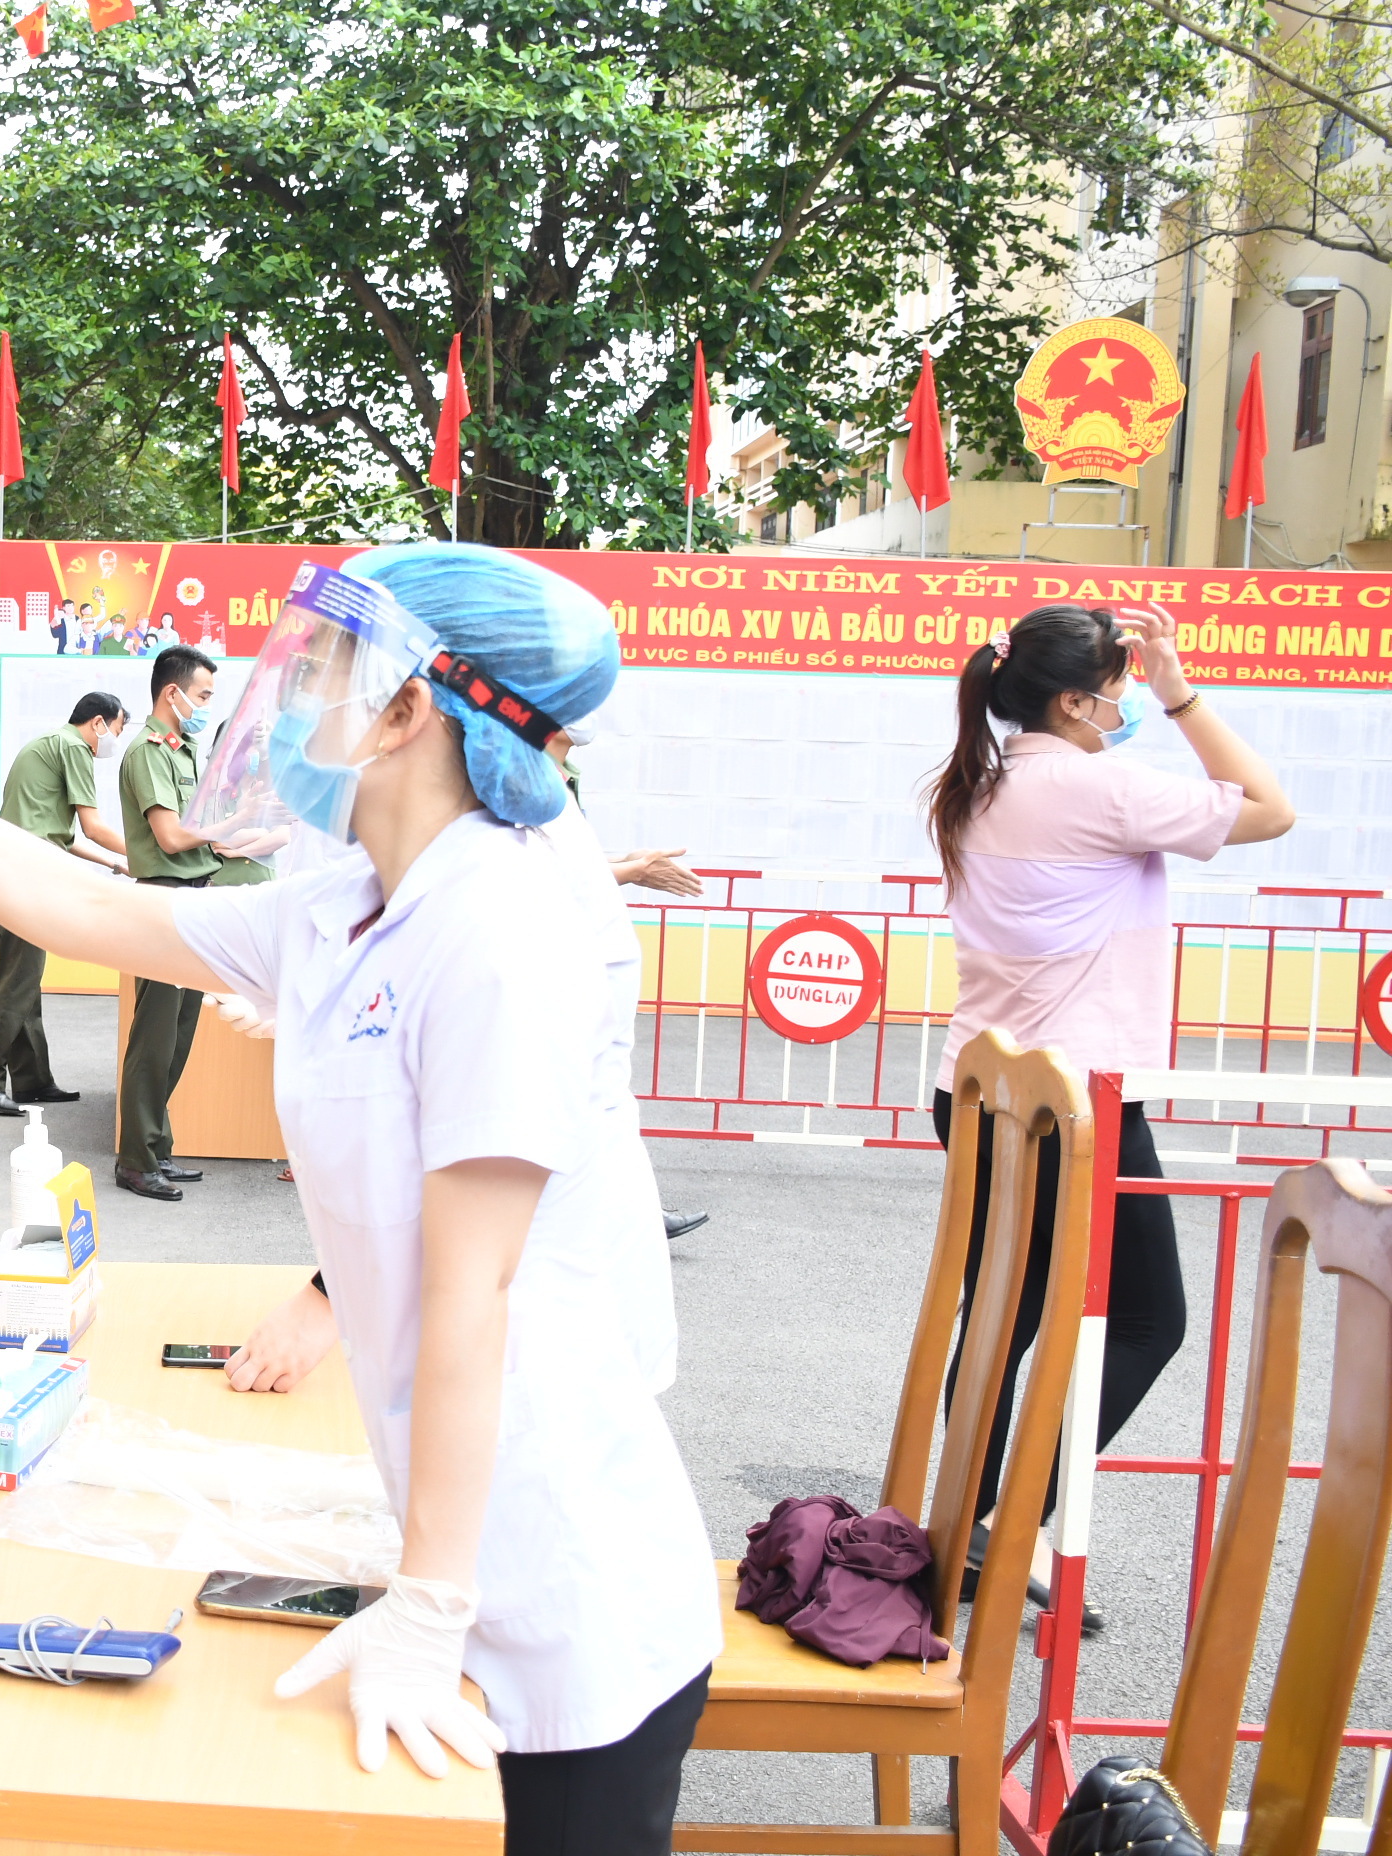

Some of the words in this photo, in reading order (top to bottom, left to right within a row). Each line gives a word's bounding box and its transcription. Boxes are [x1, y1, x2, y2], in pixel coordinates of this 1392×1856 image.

[1072, 456, 1094, 465] VIỆT
[1095, 456, 1114, 467] NAM
[652, 565, 747, 590] NƠI
[762, 565, 901, 594] NIÊM
[915, 565, 1018, 598] YẾT
[1032, 577, 1187, 603] DANH
[1201, 577, 1343, 607] SÁCH
[1357, 586, 1392, 608] C
[229, 588, 287, 627] BẦU
[607, 599, 638, 641] ỘI
[647, 602, 732, 637] KHÓA
[740, 609, 783, 640] XV
[791, 605, 831, 641] VÀ
[841, 603, 905, 644] BẦU
[914, 606, 962, 645] CỬ
[1175, 613, 1267, 654] ĐỒNG
[1275, 621, 1370, 658] NHÂN
[643, 647, 689, 664] VỰC
[695, 646, 728, 662] BỎ
[733, 647, 800, 665] PHIẾU
[805, 649, 837, 666] SỐ
[842, 654, 855, 667] 6
[861, 653, 956, 670] PHƯỜNG
[1181, 661, 1229, 679] ỒNG
[1235, 664, 1308, 684] BÀNG,
[1313, 667, 1392, 684] THÀNH
[782, 950, 851, 971] CAHP
